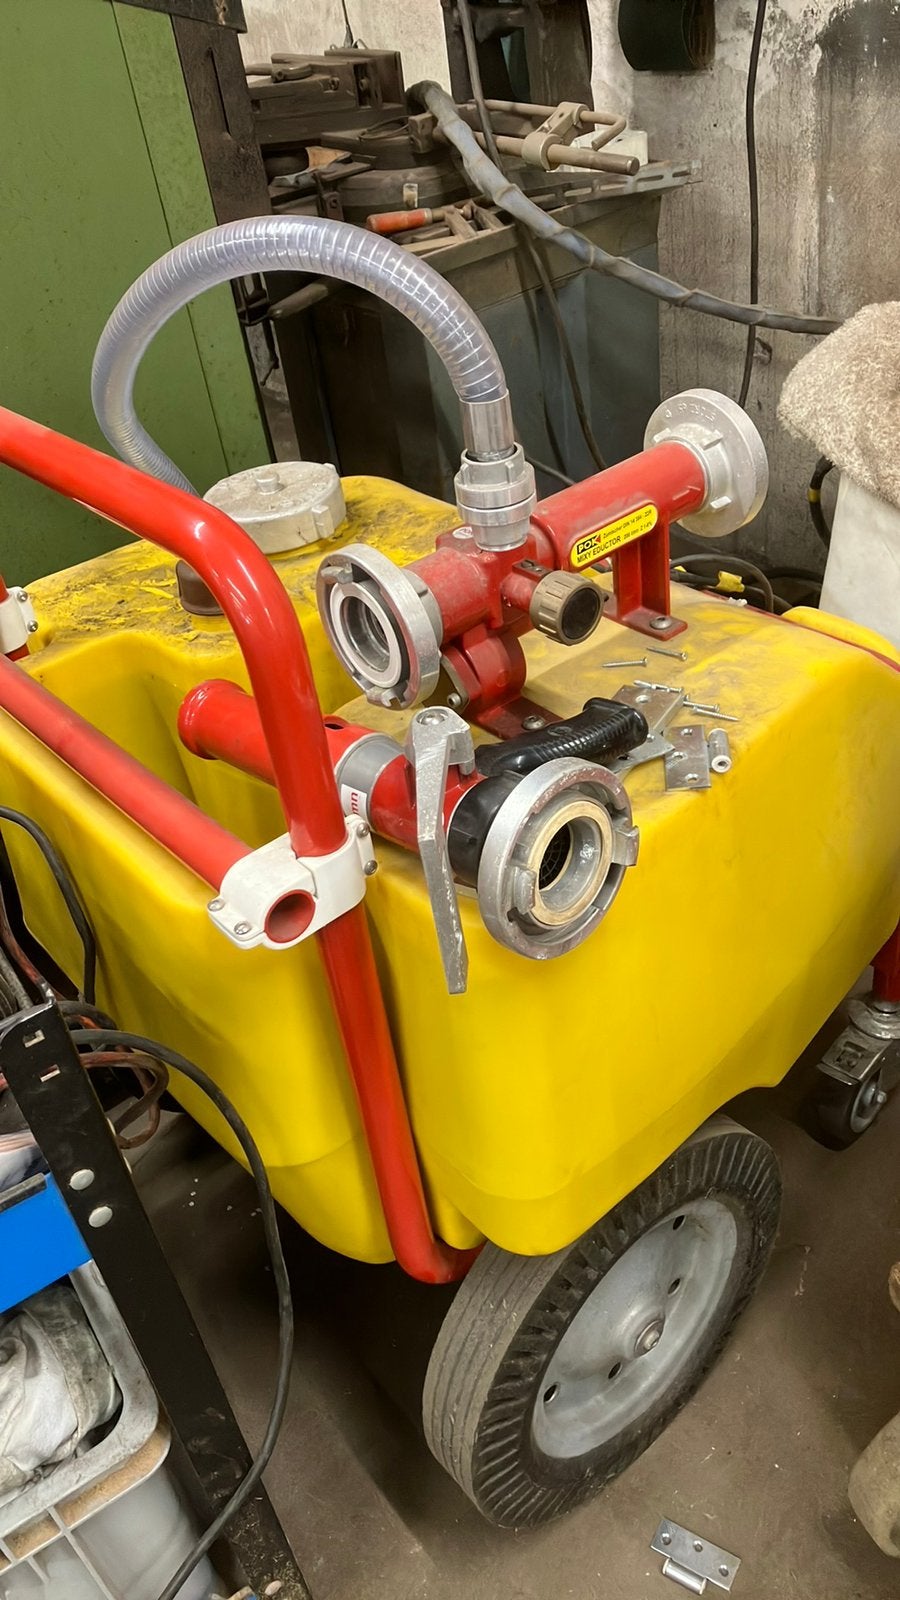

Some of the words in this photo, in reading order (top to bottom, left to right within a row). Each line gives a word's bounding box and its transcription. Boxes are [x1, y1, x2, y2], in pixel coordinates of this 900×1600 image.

[577, 534, 602, 555] POK
[577, 551, 592, 563] MIXY
[593, 535, 621, 555] EDUCTOR
